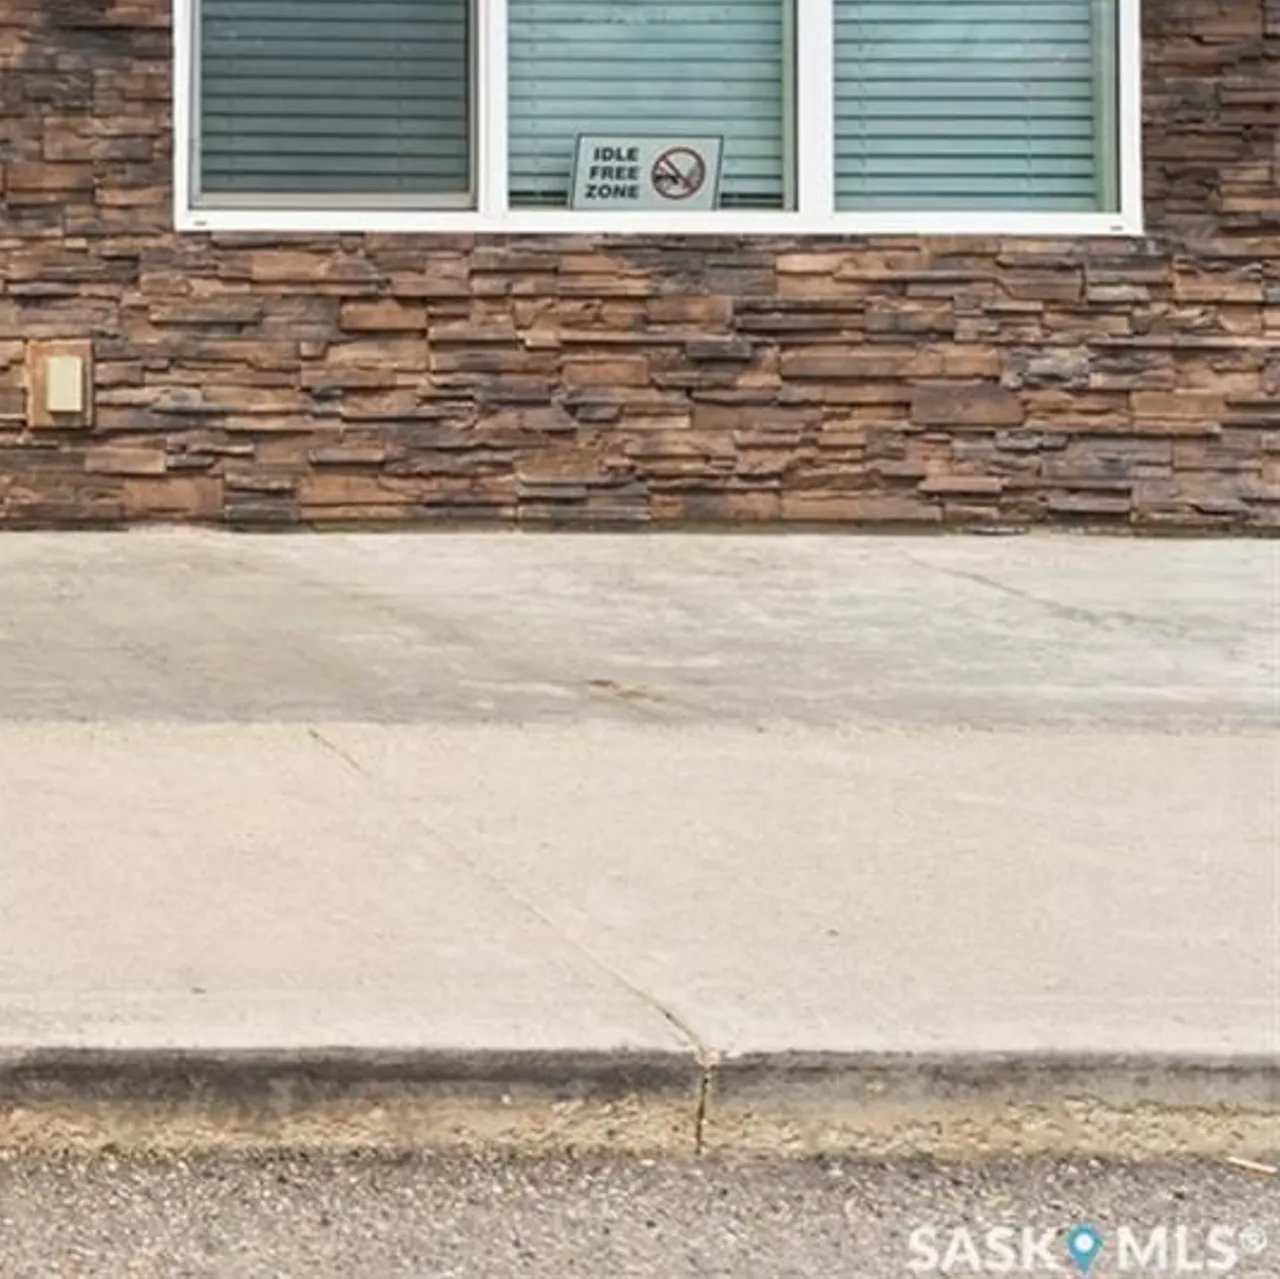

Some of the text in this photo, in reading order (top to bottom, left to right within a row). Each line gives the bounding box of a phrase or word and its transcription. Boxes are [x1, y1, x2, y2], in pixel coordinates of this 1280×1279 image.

[593, 147, 640, 162] IDLE
[589, 166, 639, 181] FREE
[584, 184, 640, 199] ZONE
